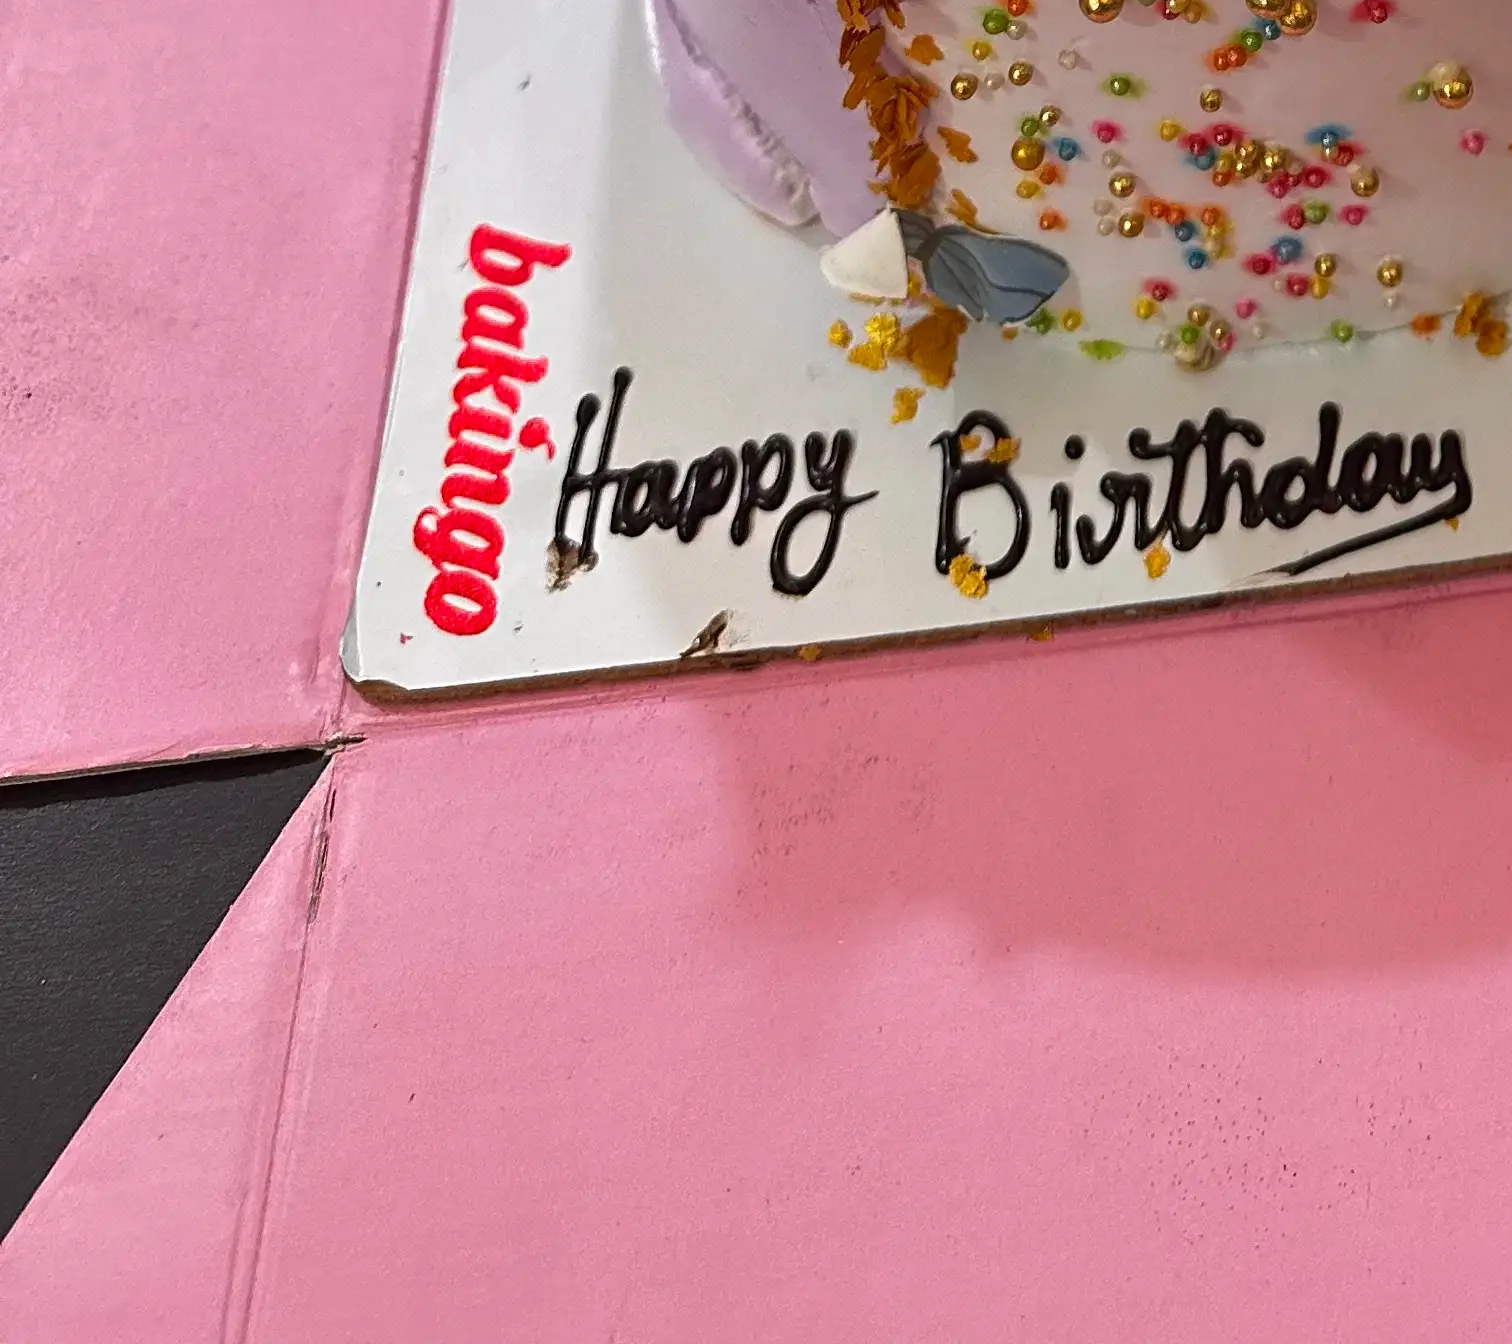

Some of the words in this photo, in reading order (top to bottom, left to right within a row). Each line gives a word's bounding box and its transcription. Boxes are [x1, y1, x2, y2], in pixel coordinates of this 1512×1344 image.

[412, 223, 571, 636] bakingo
[552, 367, 879, 596] Happy
[930, 401, 1472, 579] Birthday
